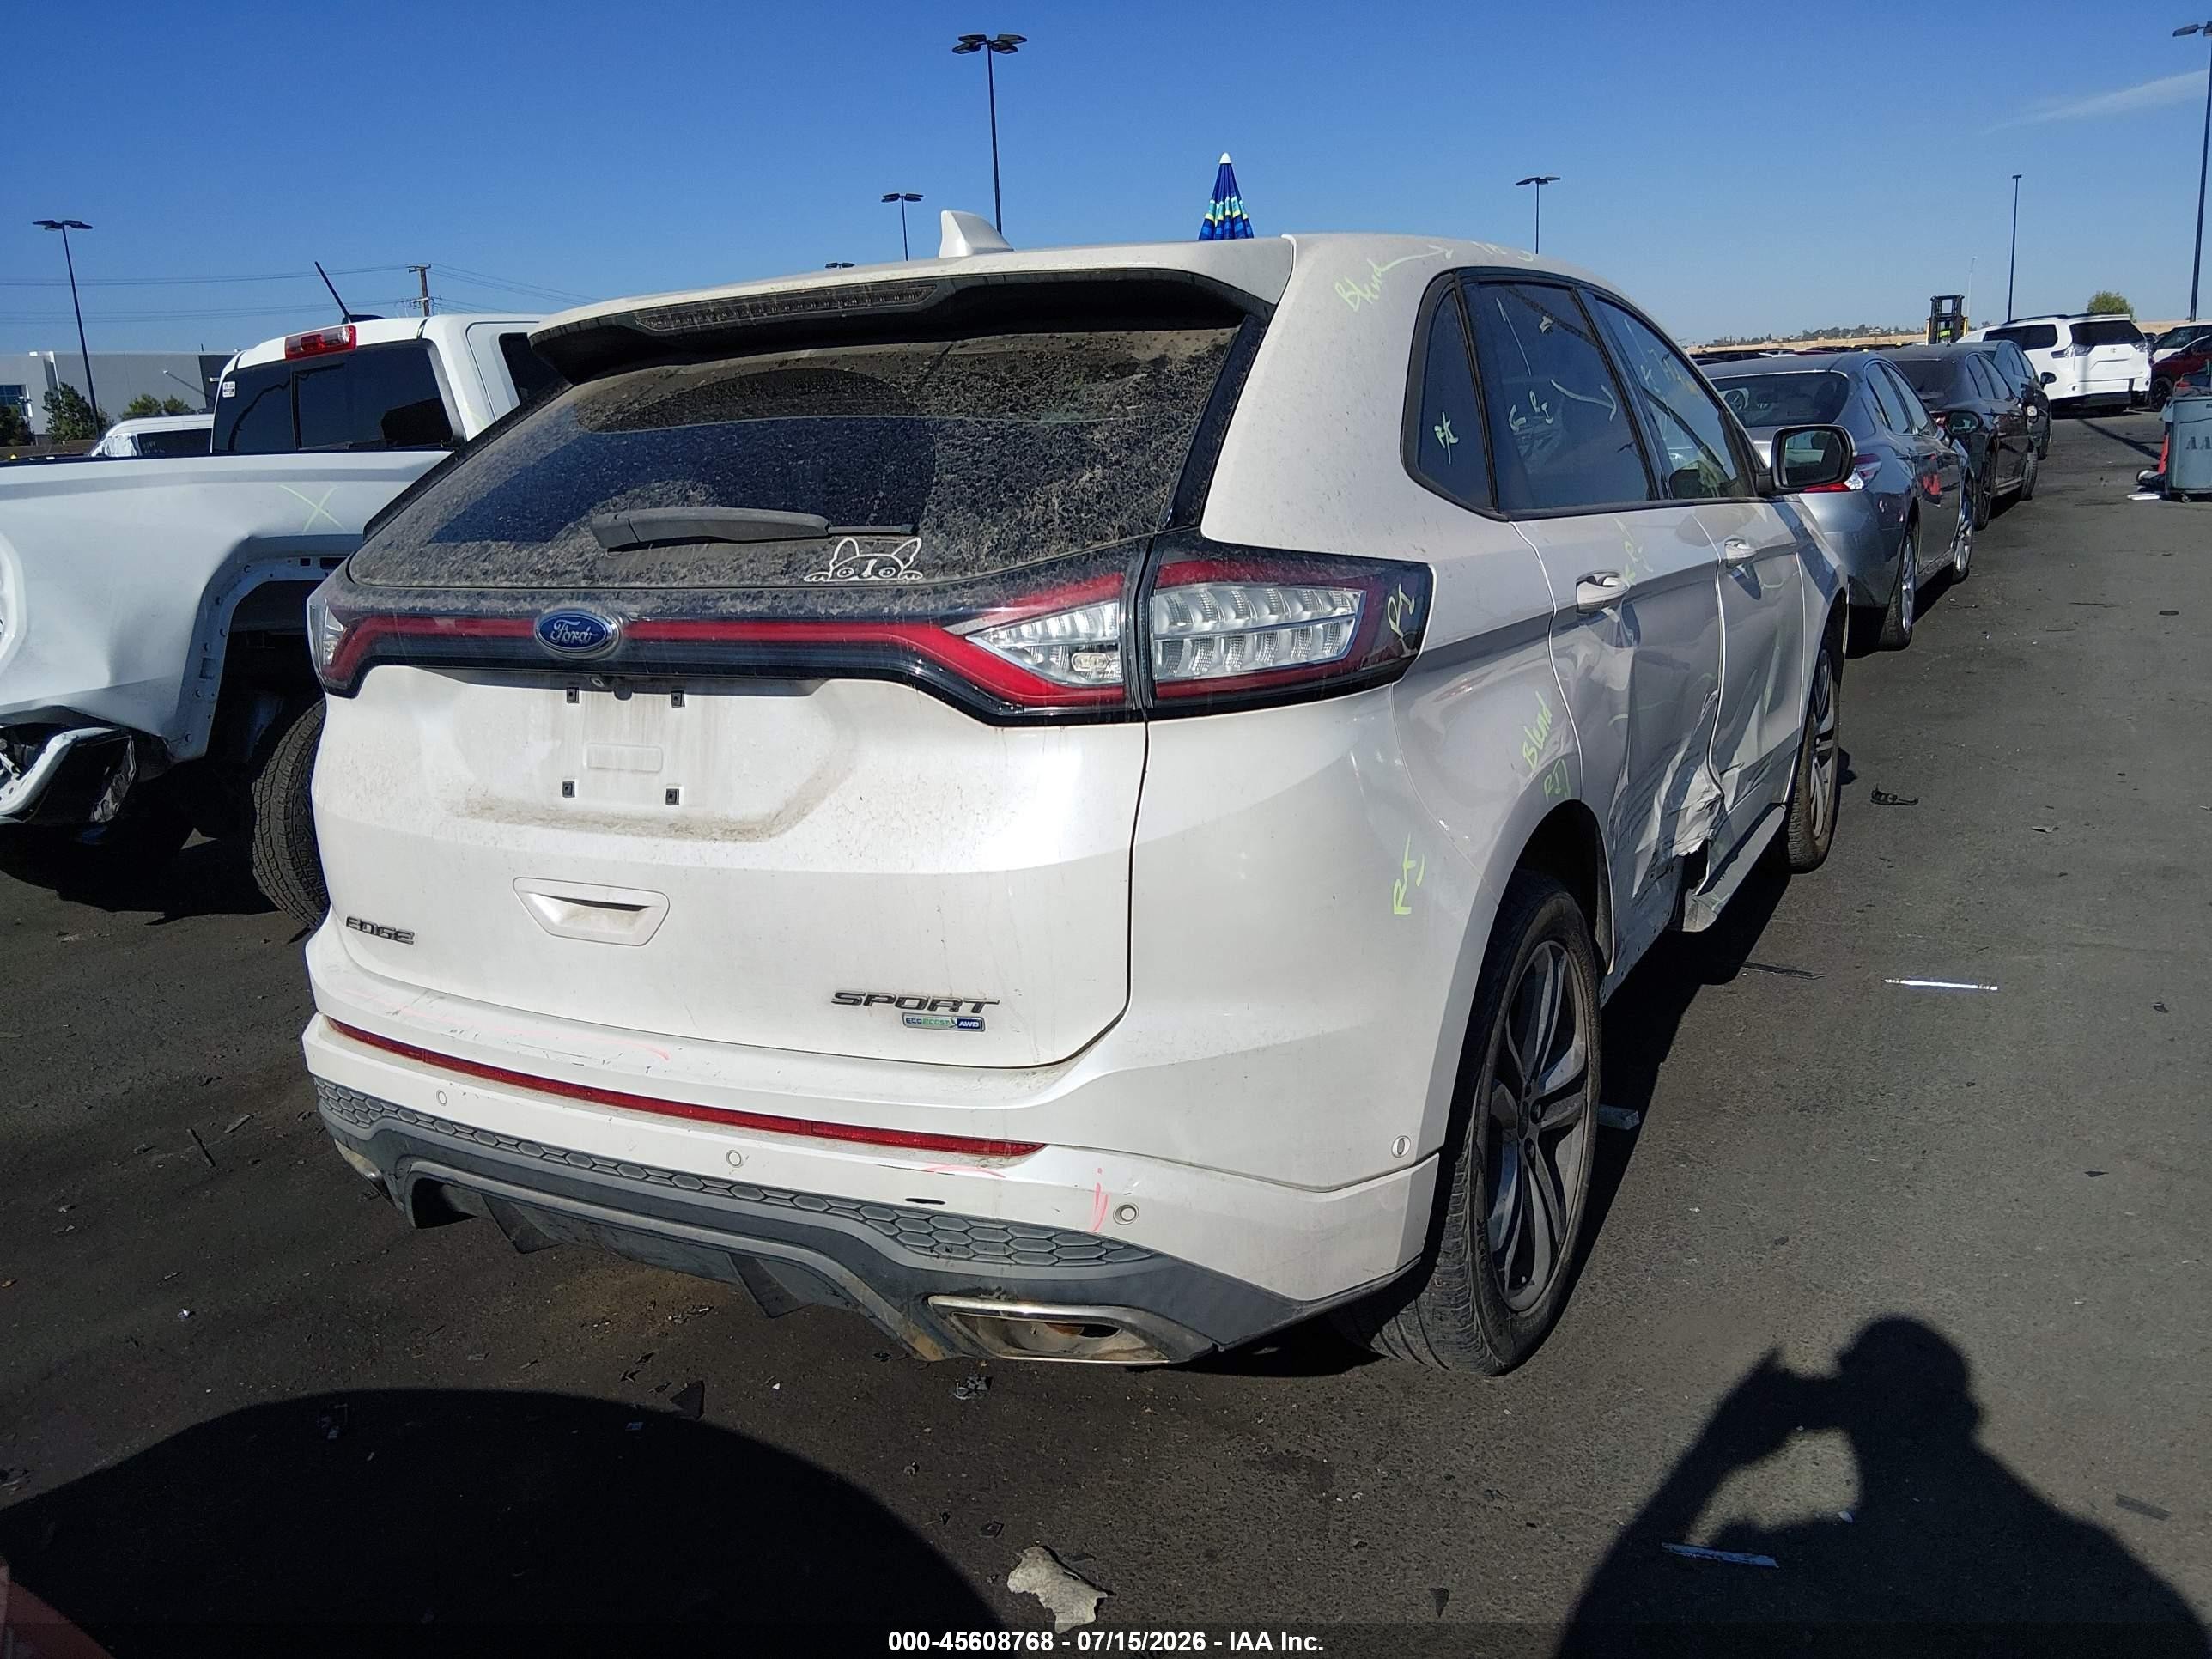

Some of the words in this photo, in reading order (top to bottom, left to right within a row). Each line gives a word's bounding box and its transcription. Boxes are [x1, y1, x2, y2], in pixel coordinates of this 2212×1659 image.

[550, 619, 599, 644] Ford
[345, 916, 415, 945] EDGE
[830, 991, 1000, 1014] SPORT
